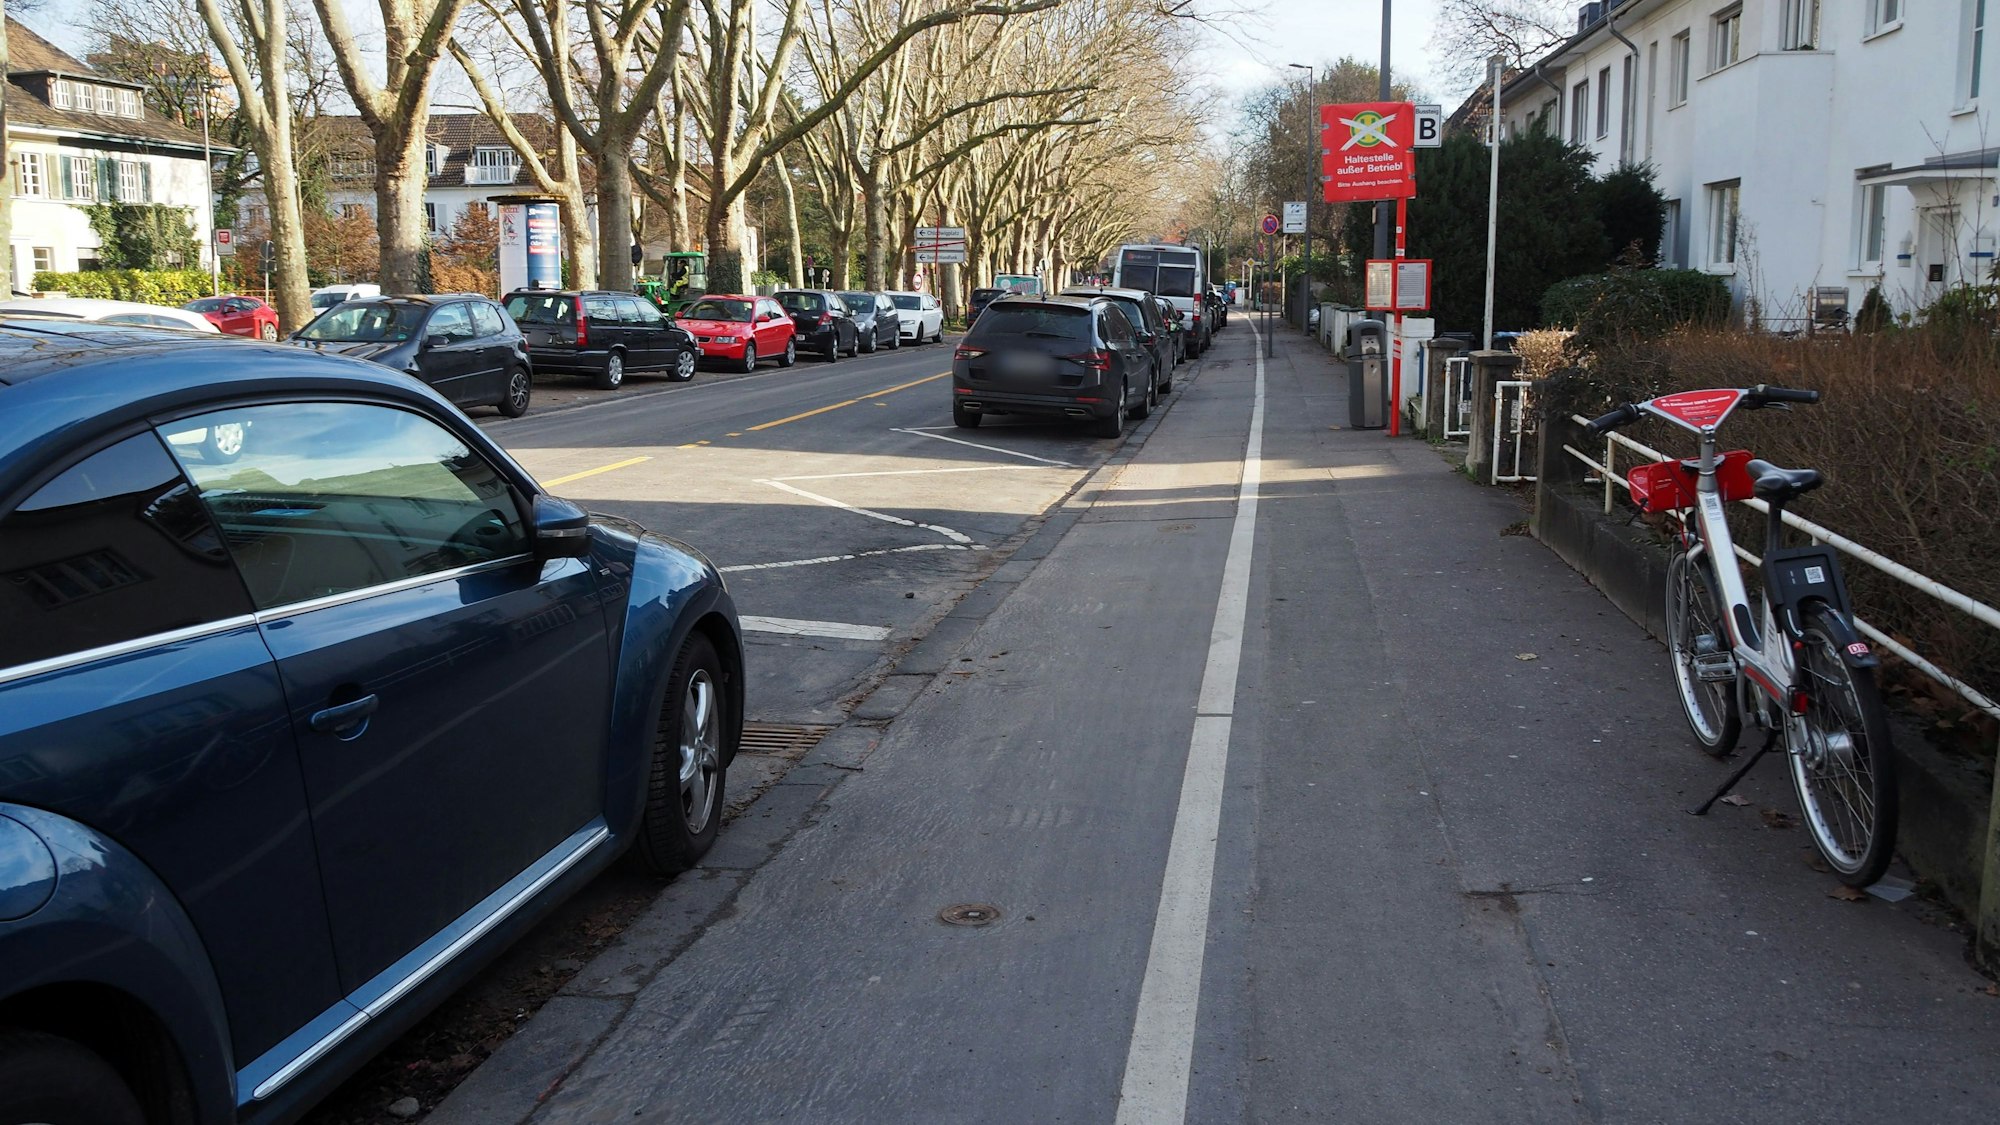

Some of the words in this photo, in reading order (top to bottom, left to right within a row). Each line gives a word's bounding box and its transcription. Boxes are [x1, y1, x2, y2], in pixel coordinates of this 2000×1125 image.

[1420, 118, 1436, 139] B
[1344, 153, 1394, 164] Haltestelle
[1337, 165, 1364, 175] außer
[1367, 162, 1403, 172] Betrieb!
[1850, 644, 1869, 653] DB
